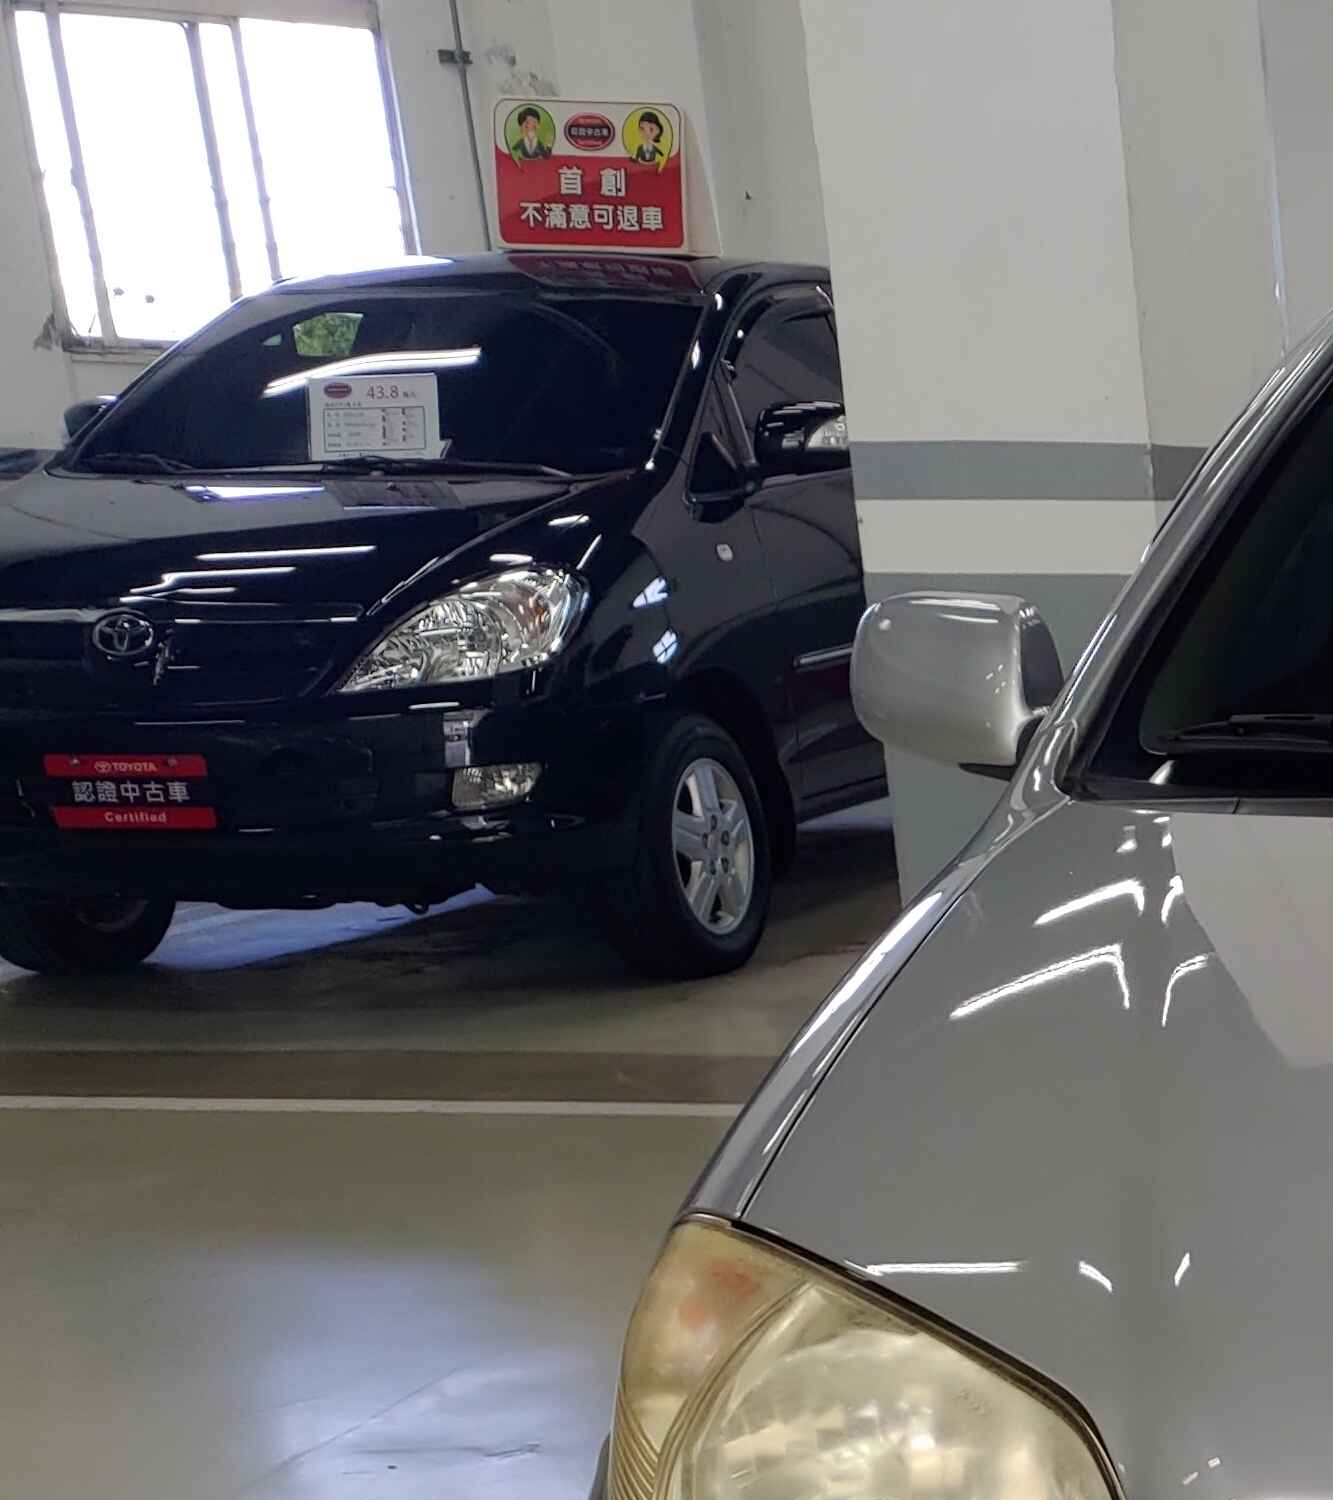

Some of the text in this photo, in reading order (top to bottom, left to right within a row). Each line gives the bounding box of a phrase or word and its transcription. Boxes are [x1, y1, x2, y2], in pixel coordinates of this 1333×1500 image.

[519, 202, 663, 231] 不滿意可退車
[366, 385, 399, 399] 43.8
[112, 762, 157, 772] TOYOTA
[72, 780, 190, 803] 認證中古車
[104, 811, 167, 823] Certified
